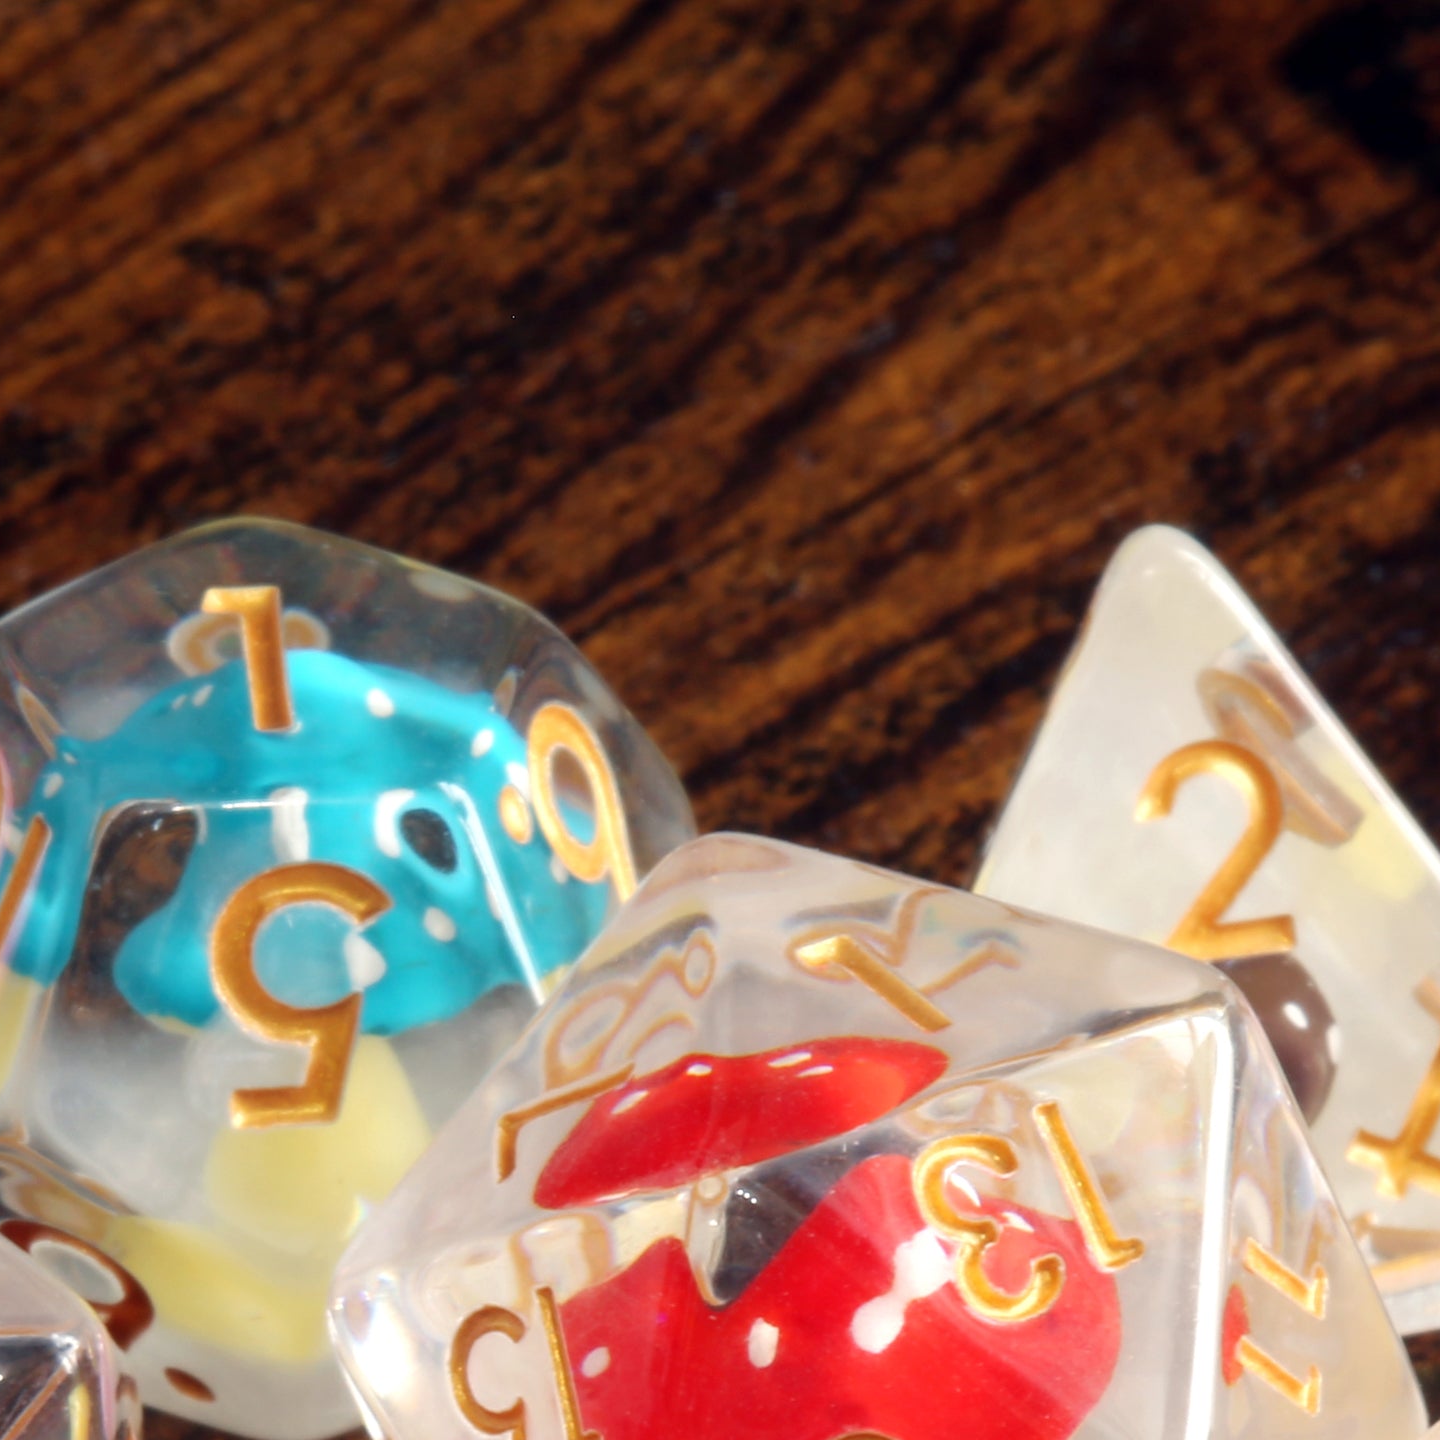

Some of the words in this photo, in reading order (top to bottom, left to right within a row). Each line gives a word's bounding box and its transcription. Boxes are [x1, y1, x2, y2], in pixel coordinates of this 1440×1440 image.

[202, 585, 298, 733] 1
[1133, 738, 1298, 964] 2
[210, 860, 394, 1132] 5
[912, 1100, 1145, 1324] 13
